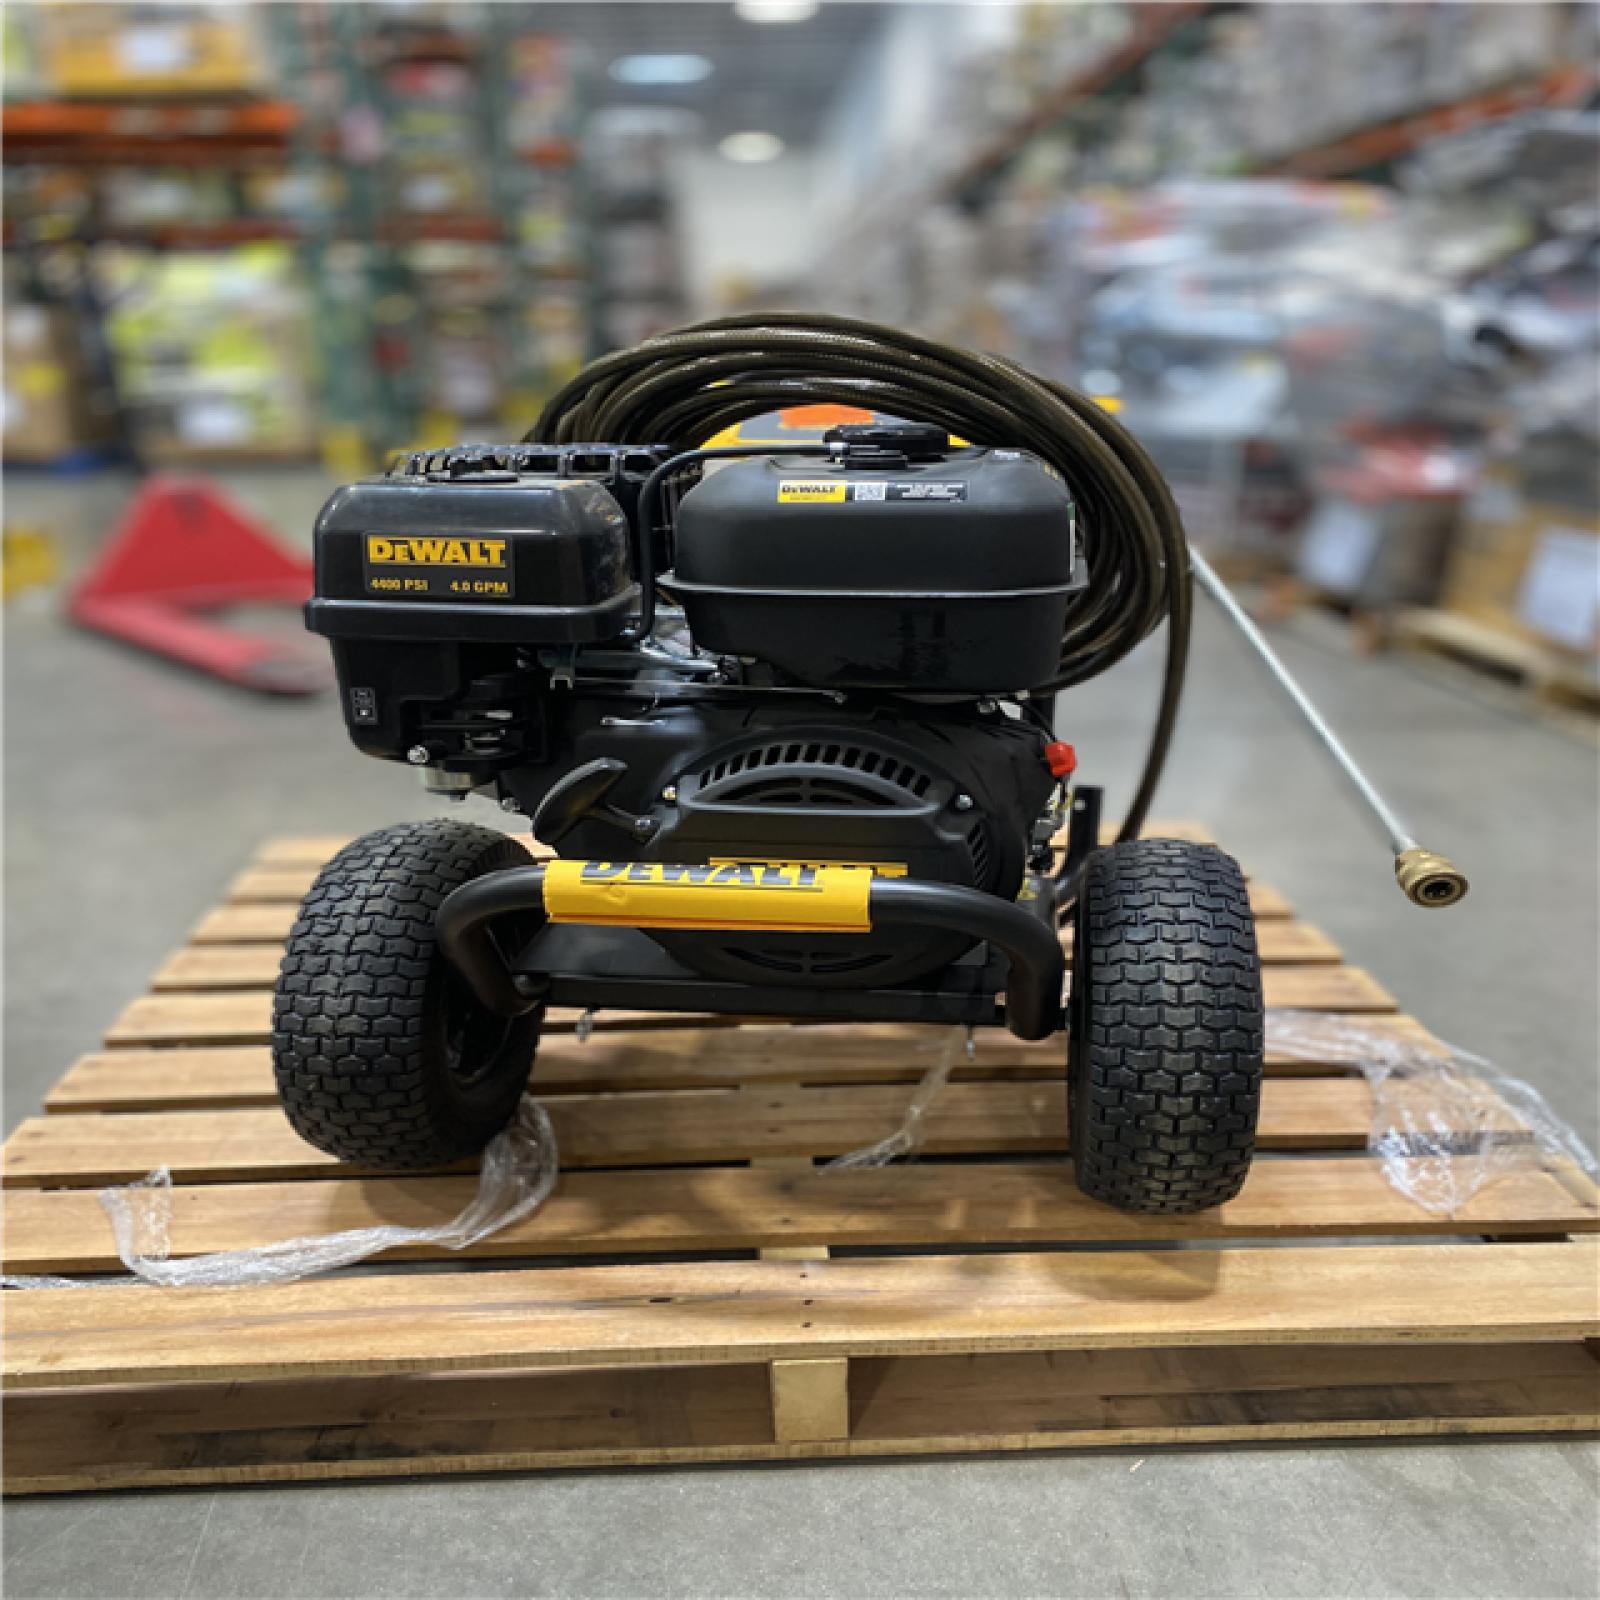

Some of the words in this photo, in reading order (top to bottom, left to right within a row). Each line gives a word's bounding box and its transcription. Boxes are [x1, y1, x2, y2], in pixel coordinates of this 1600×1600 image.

[404, 579, 429, 591] PSI
[450, 581, 471, 592] 4.0
[474, 581, 508, 593] GPM
